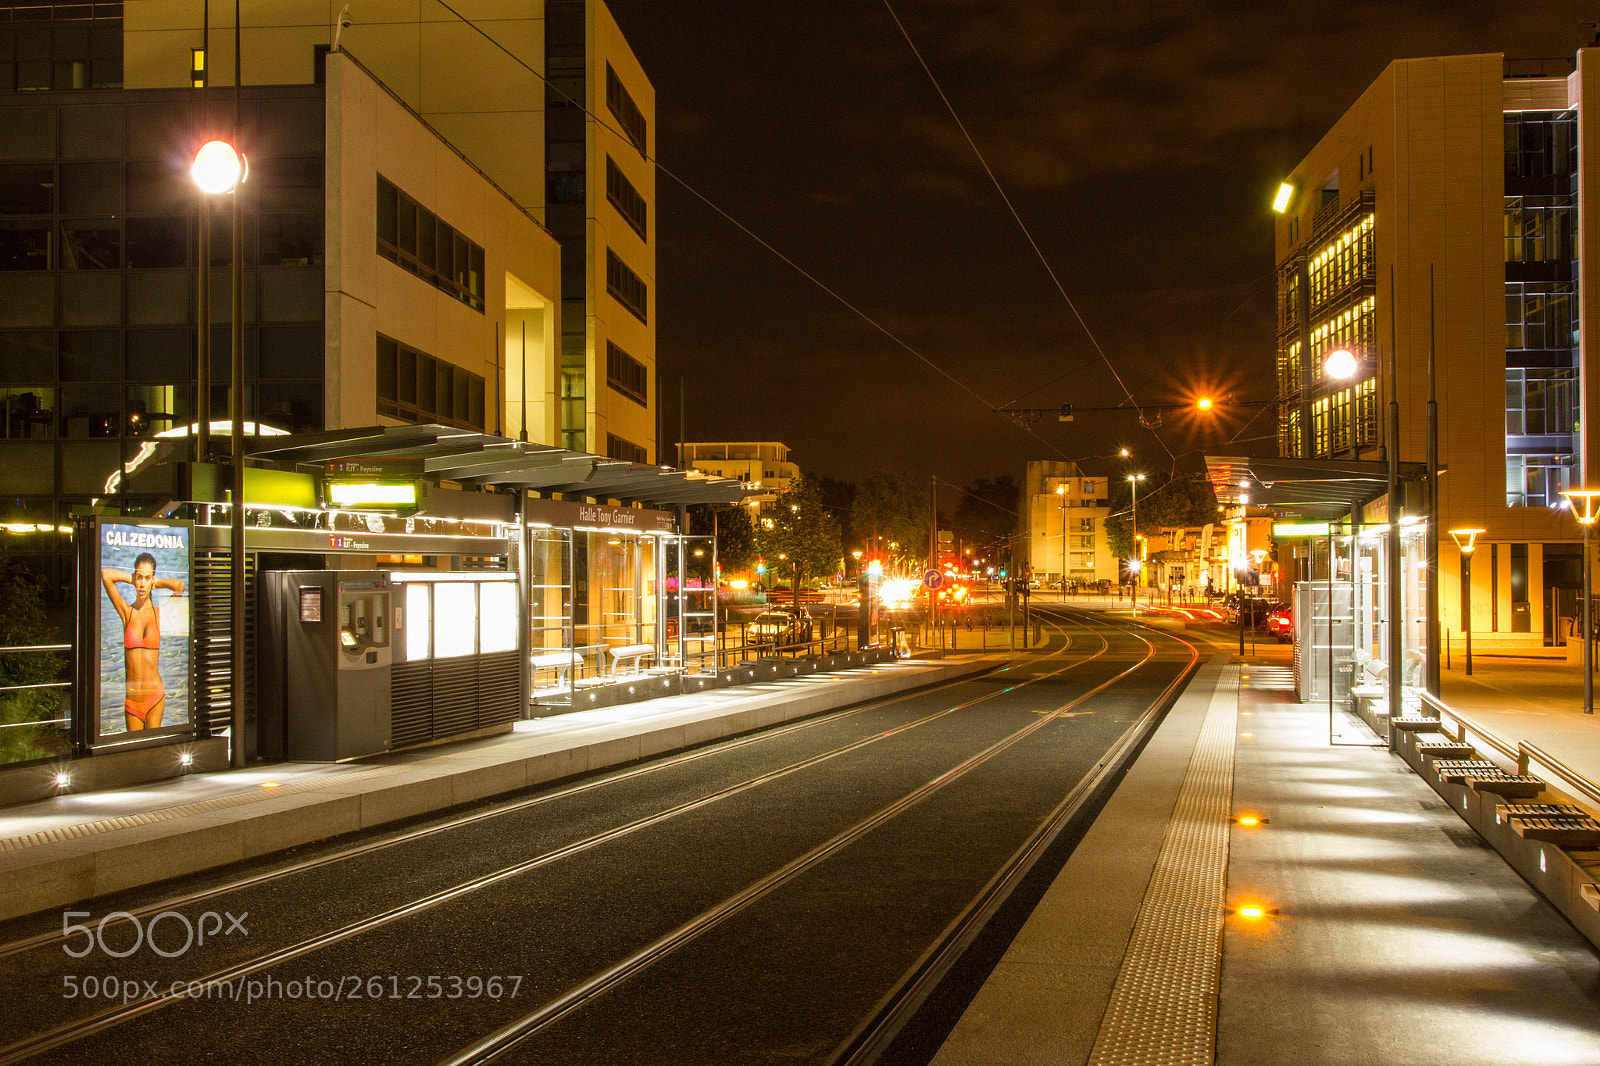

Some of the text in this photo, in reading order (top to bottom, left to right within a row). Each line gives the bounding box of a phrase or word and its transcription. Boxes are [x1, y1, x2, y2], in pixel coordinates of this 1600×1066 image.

[579, 506, 636, 526] Halle Tony Garnier
[105, 530, 185, 549] CALZEDONIA
